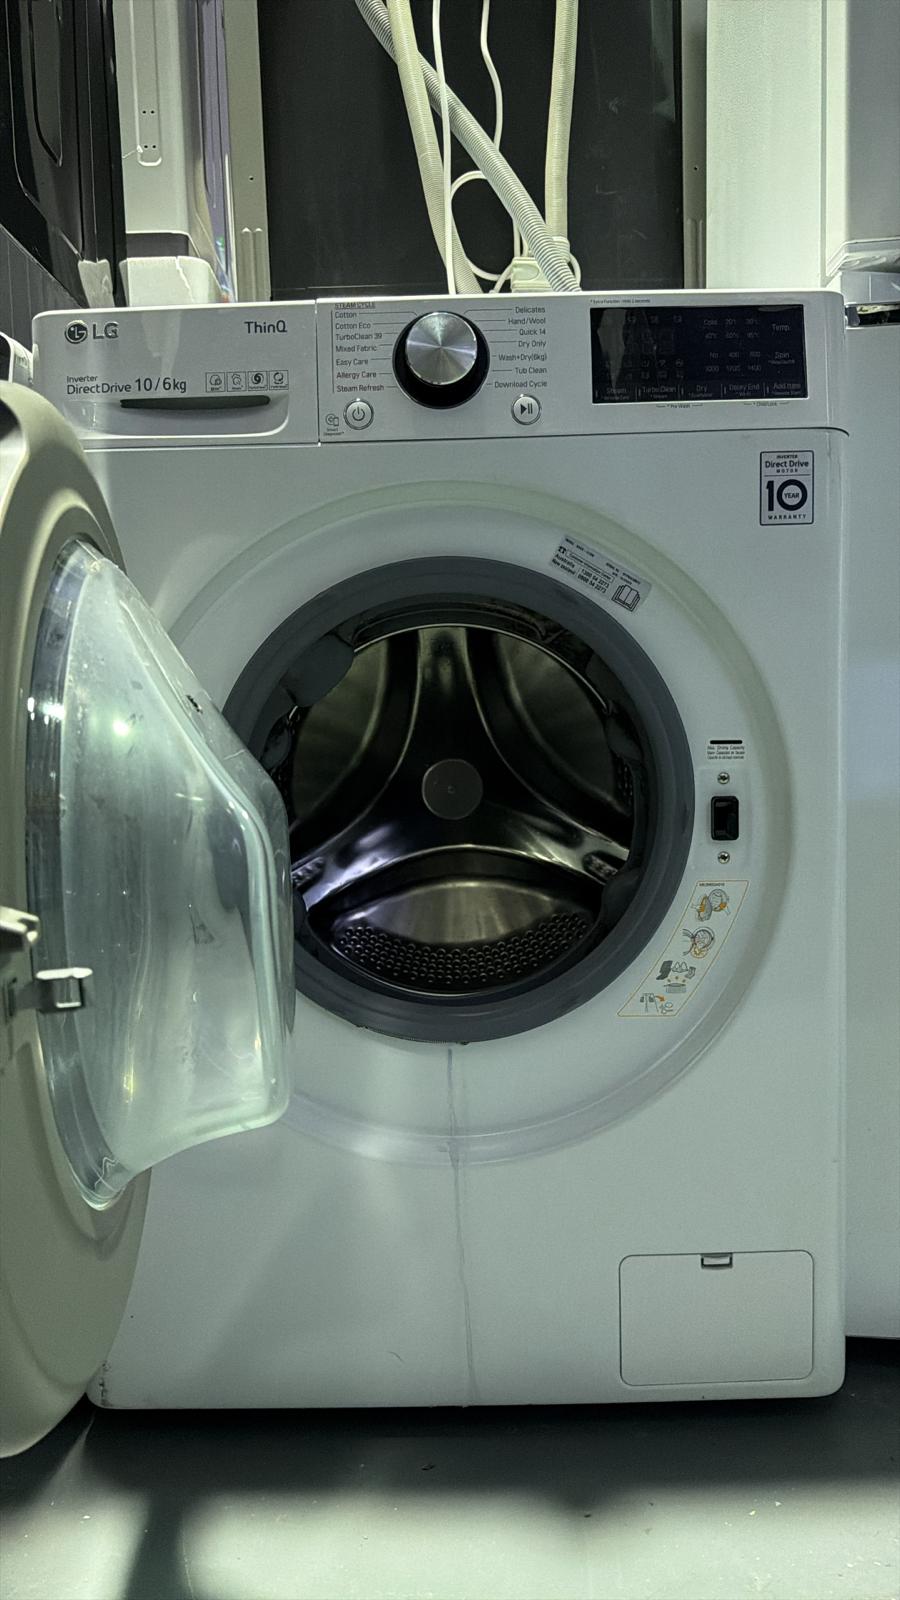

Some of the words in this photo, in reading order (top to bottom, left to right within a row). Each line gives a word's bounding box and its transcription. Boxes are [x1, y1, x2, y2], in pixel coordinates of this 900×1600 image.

[515, 306, 546, 314] Delicates
[335, 311, 357, 319] Cotton
[244, 320, 287, 334] ThinQ
[335, 322, 357, 330] Cotton
[92, 322, 119, 340] LG
[519, 328, 538, 336] Quick
[336, 333, 373, 341] TurboClean
[357, 344, 377, 352] Fabric
[518, 340, 530, 348] Dry
[531, 340, 547, 348] Only
[336, 358, 352, 367] Easy
[353, 358, 368, 366] Care
[528, 366, 547, 374] Clean
[336, 371, 360, 380] Allergy
[361, 371, 377, 379] Care
[337, 385, 358, 393] Steam
[359, 384, 385, 392] Refresh
[494, 381, 528, 389] Download
[529, 380, 548, 388] Cycle
[789, 460, 809, 468] Drive
[766, 479, 808, 511] 10
